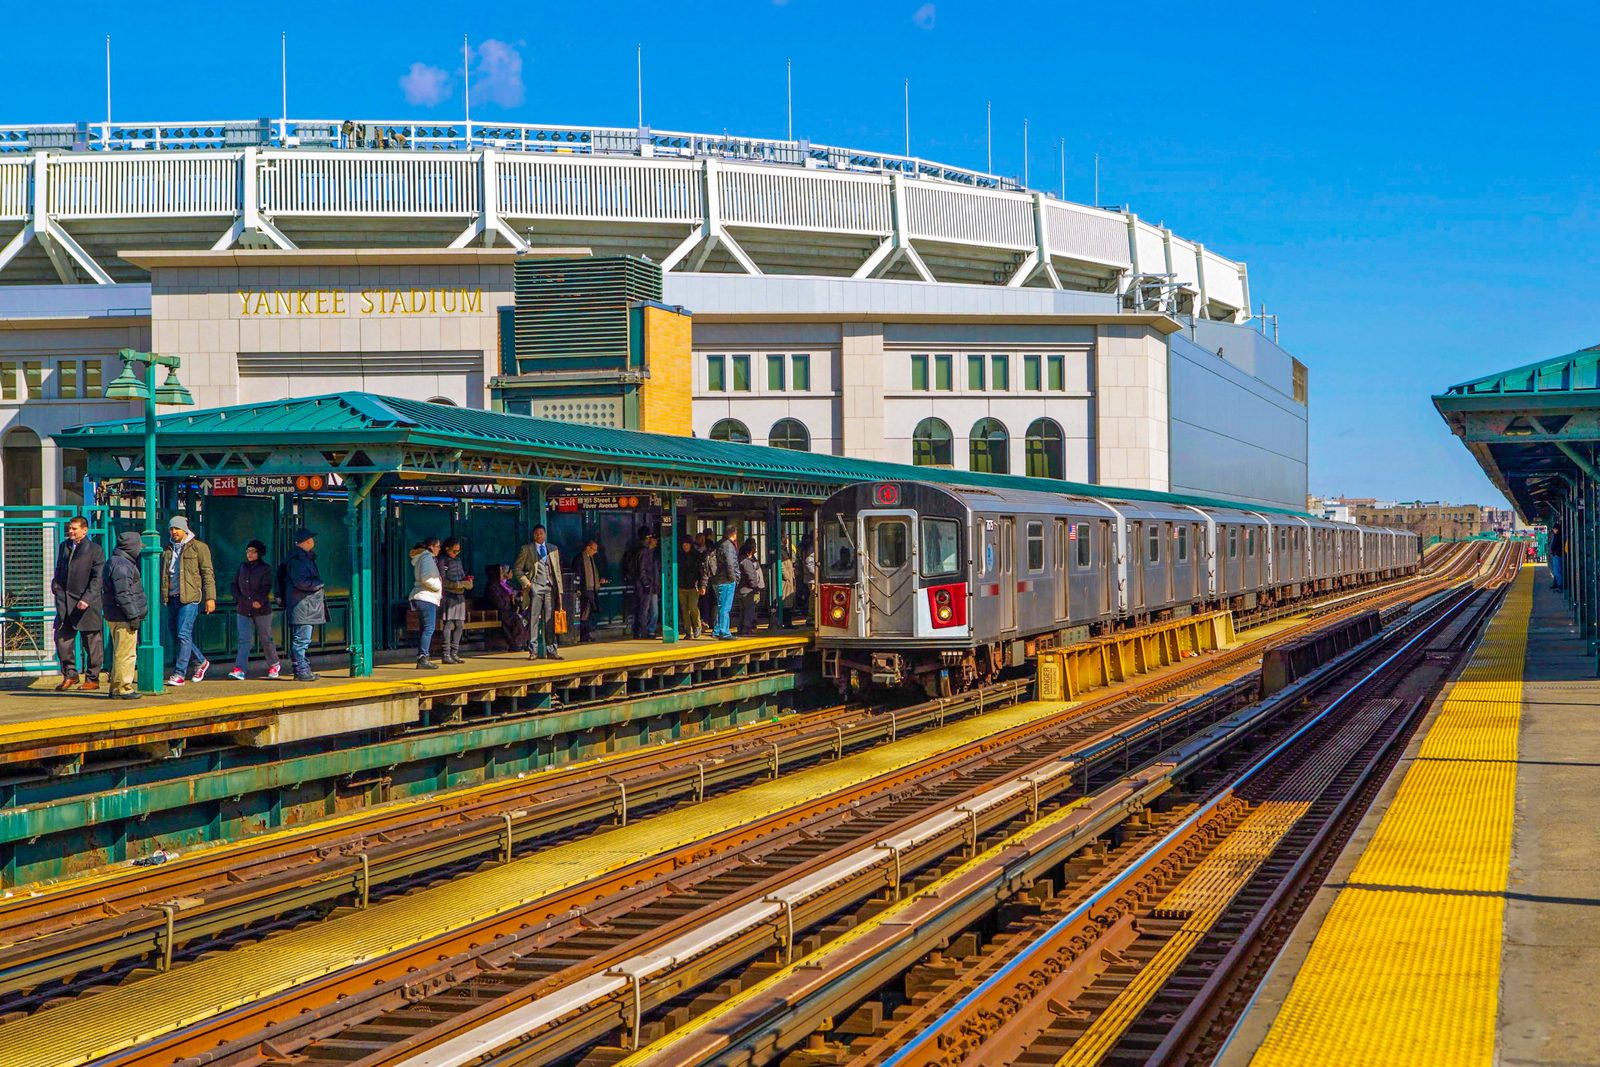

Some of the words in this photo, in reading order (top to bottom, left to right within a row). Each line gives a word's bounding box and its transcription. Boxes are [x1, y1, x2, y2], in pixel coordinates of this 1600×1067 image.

[237, 289, 346, 315] YANKEE
[360, 288, 484, 314] STADIUM
[213, 478, 235, 489] Exit
[246, 477, 259, 485] 161
[260, 477, 284, 485] Street
[287, 477, 293, 485] &
[246, 485, 266, 493] River
[267, 485, 295, 493] Avenue
[559, 497, 576, 506] Exit
